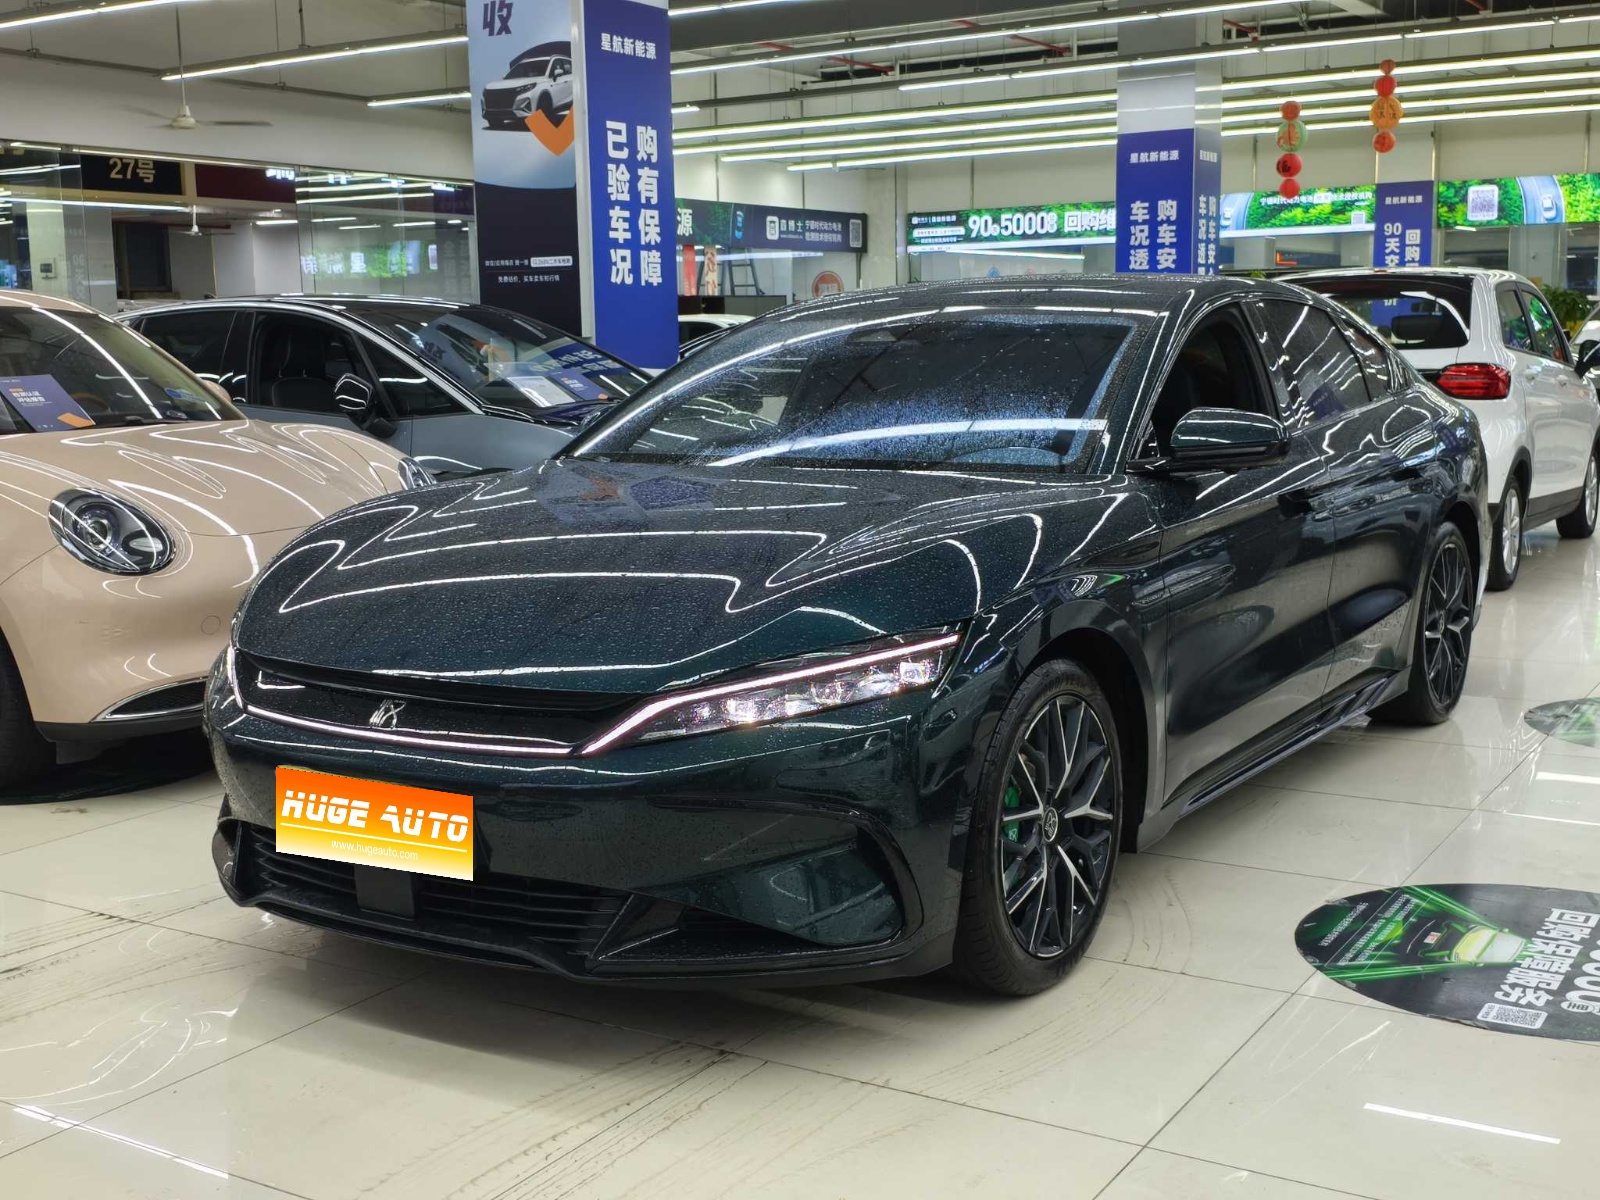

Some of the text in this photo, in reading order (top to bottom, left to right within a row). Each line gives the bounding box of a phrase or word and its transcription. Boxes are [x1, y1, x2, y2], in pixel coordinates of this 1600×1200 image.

[482, 0, 514, 36] 收
[601, 33, 657, 60] 星航新能源
[109, 157, 156, 183] 27号
[1129, 150, 1180, 164] 星航新能源
[606, 120, 633, 286] 已验车况
[636, 125, 662, 287] 购有保障
